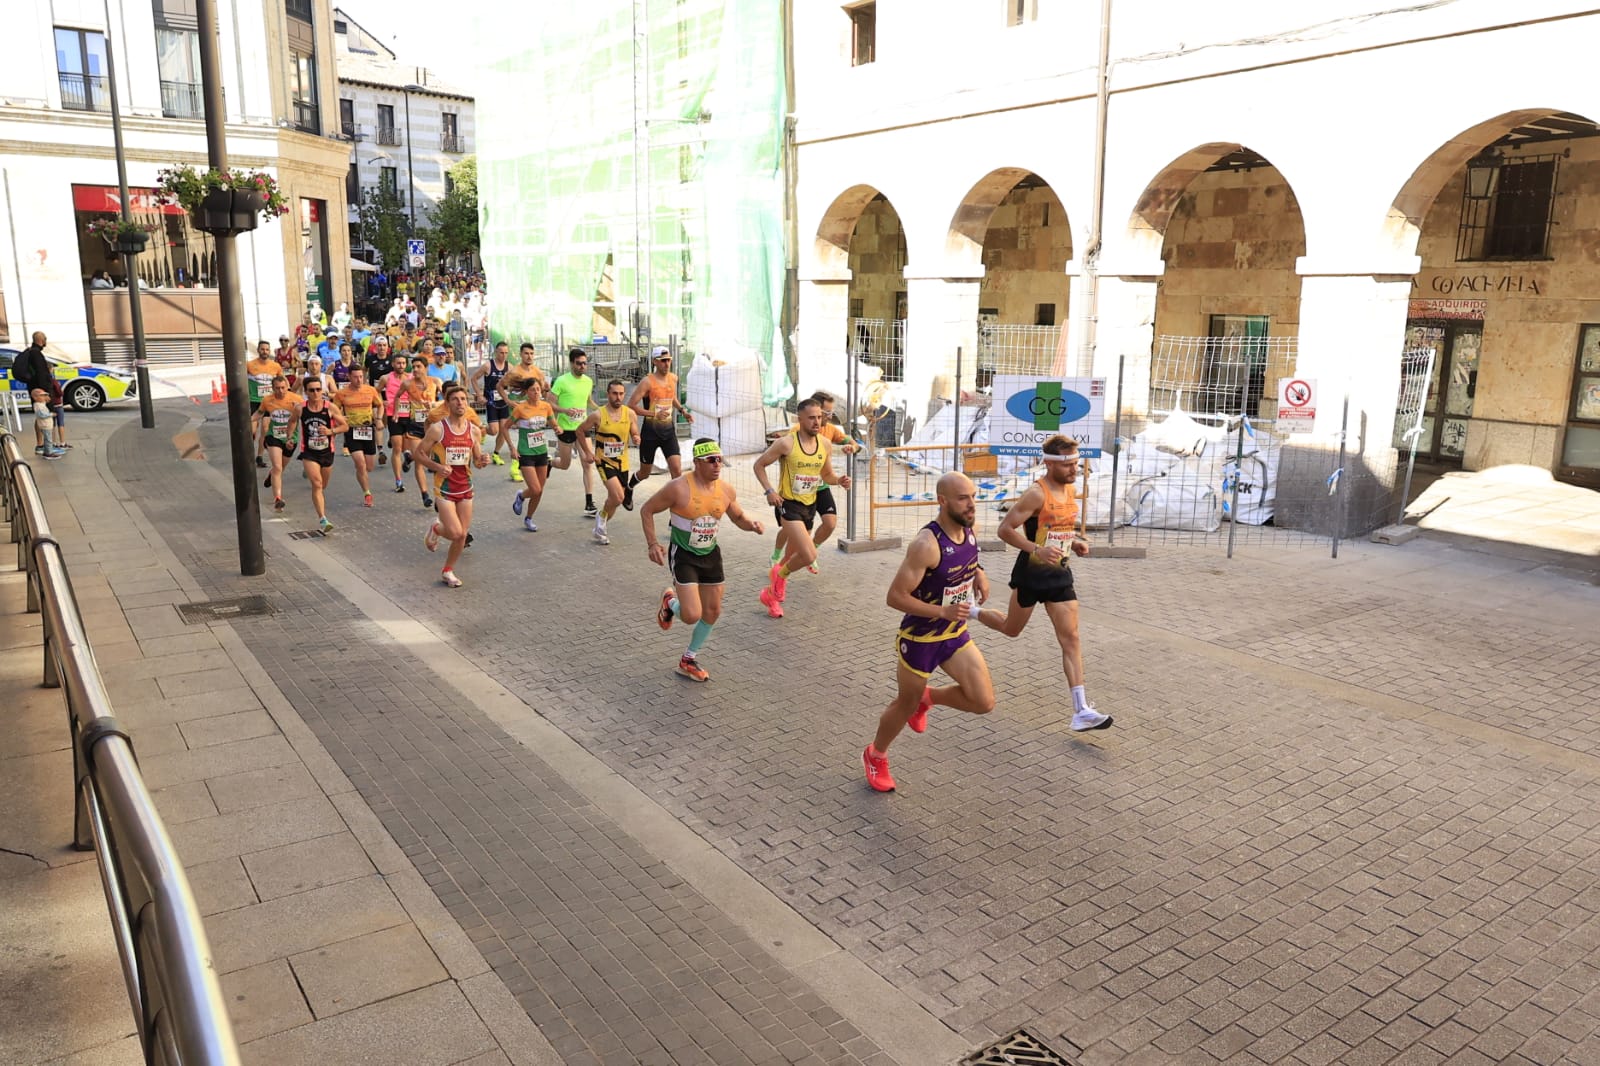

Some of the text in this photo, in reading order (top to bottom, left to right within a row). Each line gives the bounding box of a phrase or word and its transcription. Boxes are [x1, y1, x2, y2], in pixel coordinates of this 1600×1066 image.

[1028, 396, 1068, 416] CG
[1002, 431, 1060, 444] CONGE
[801, 481, 812, 489] 25
[697, 533, 714, 543] 259
